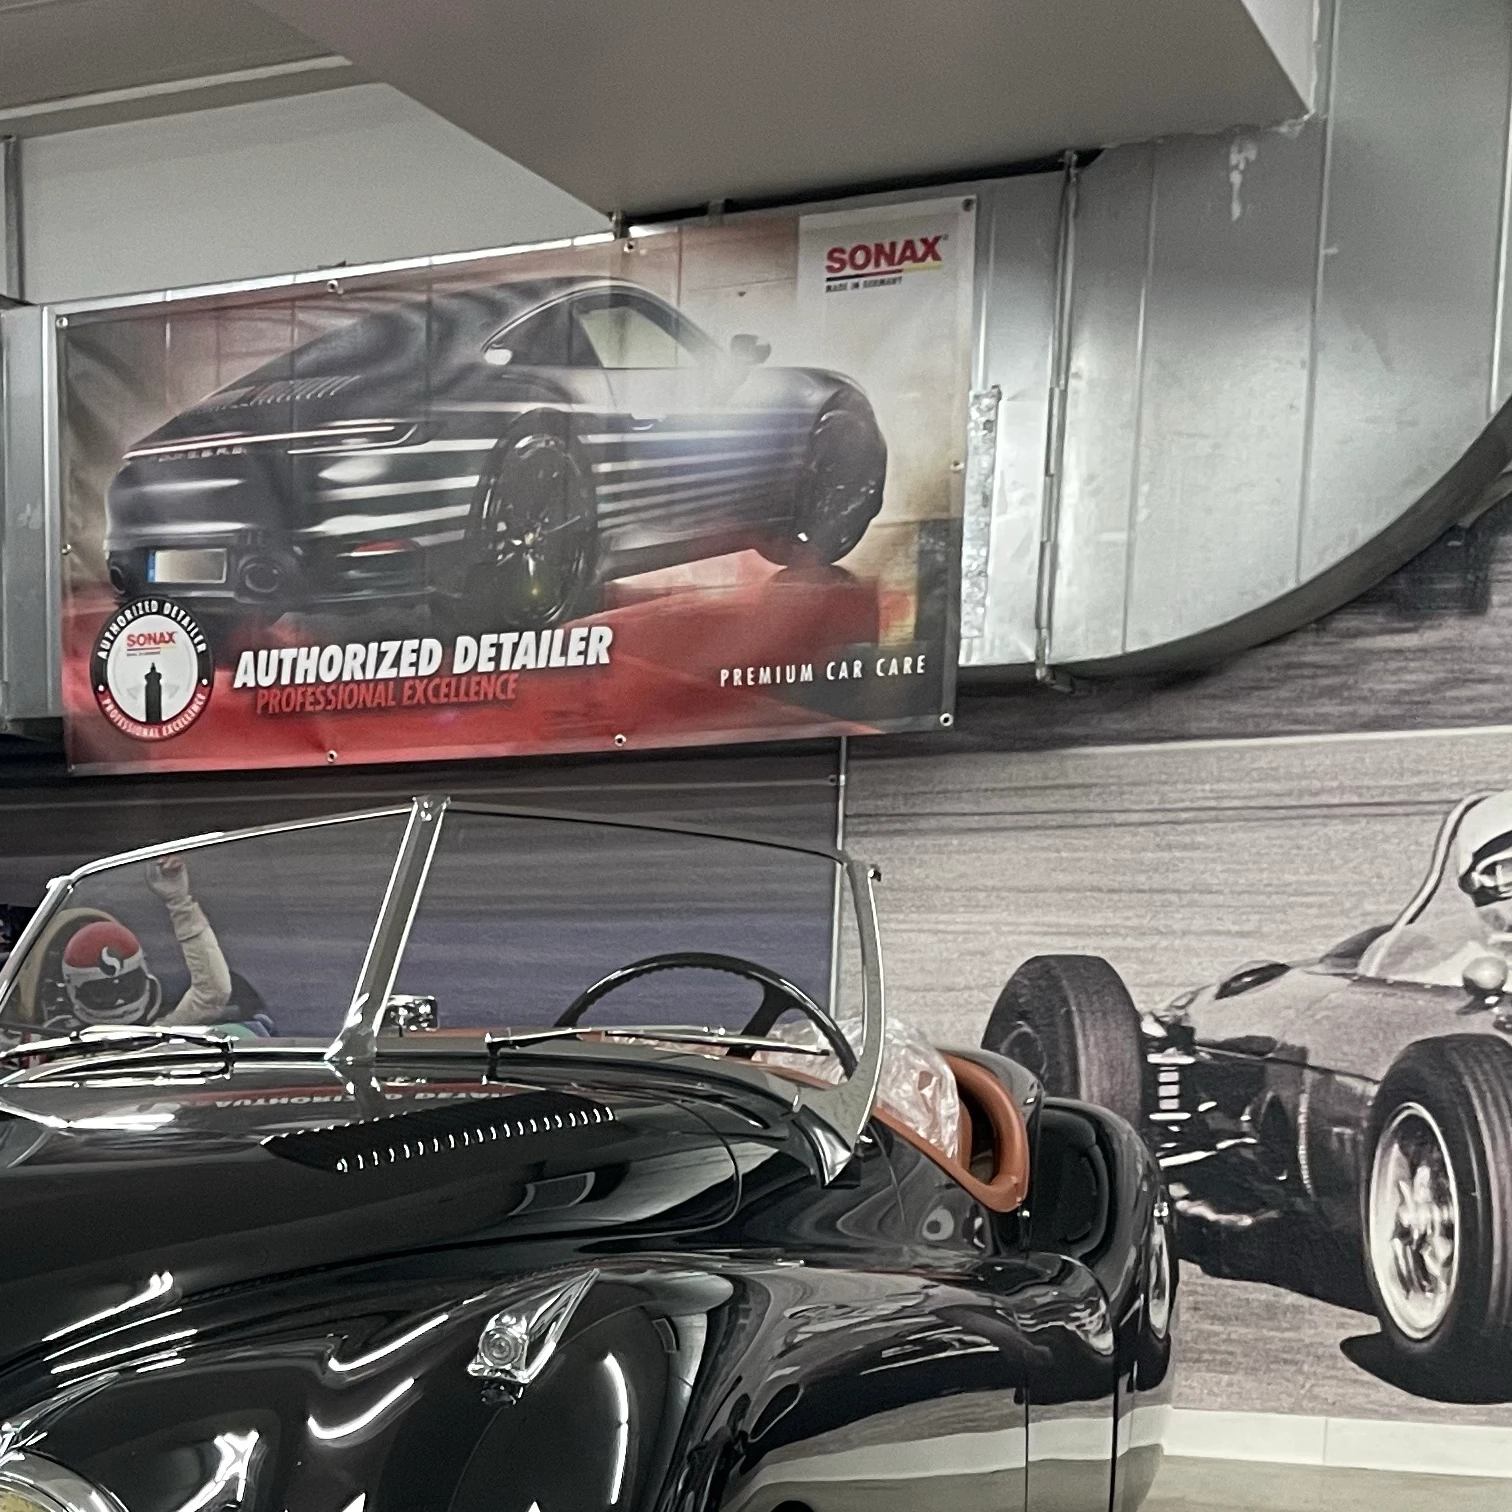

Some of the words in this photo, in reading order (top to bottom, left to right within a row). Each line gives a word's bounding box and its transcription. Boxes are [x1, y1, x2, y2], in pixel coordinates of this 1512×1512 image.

[825, 234, 943, 274] SONAX
[97, 600, 159, 660] AUTHORIZED
[162, 602, 207, 653] DETAILER
[126, 631, 177, 647] SONAX
[233, 638, 443, 689] AUTHORIZED
[452, 626, 613, 675] DETAILER
[719, 663, 814, 687] PREMIUM
[826, 659, 863, 681] CAR
[876, 655, 926, 677] CARE
[256, 681, 396, 715] PROFESSIONAL
[401, 673, 520, 708] EXCELLENCE
